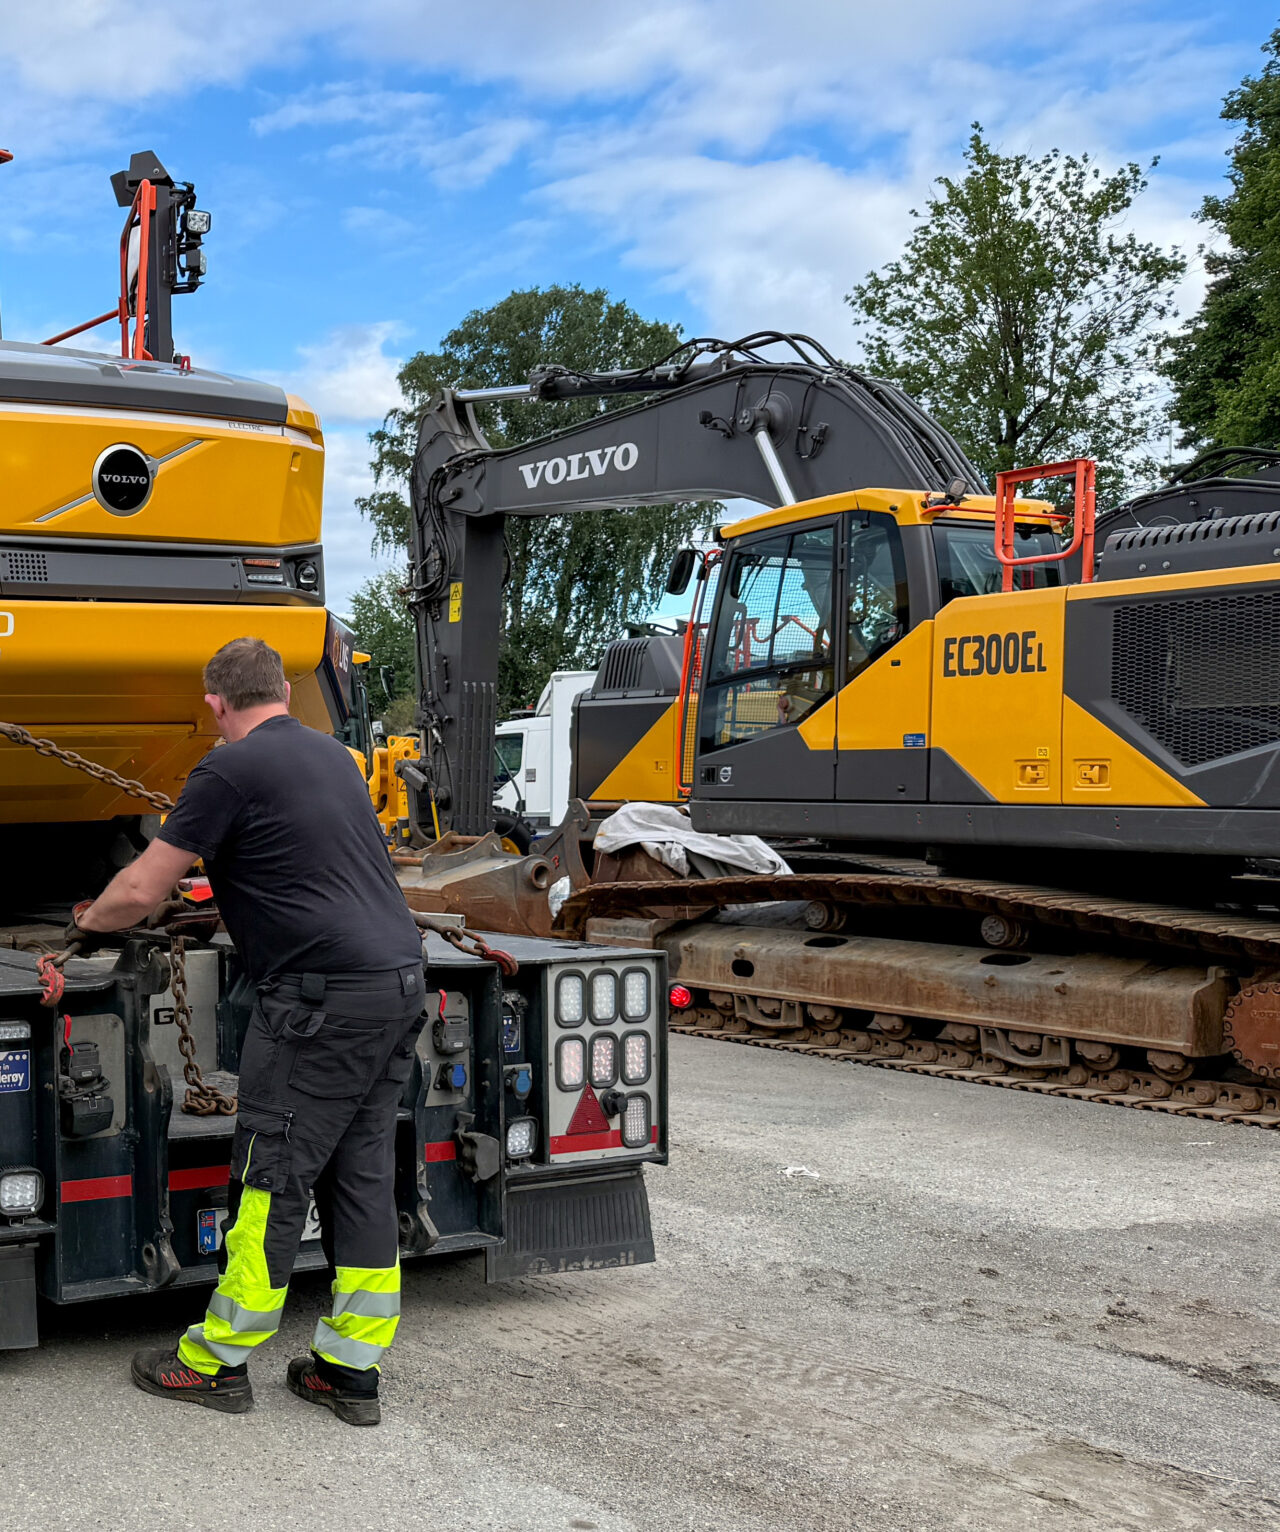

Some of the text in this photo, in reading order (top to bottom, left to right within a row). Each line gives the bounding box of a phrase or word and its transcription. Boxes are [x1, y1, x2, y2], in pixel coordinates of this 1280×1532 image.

[518, 442, 639, 489] VOLVO
[101, 474, 148, 485] VOLVO
[204, 1235, 212, 1245] N
